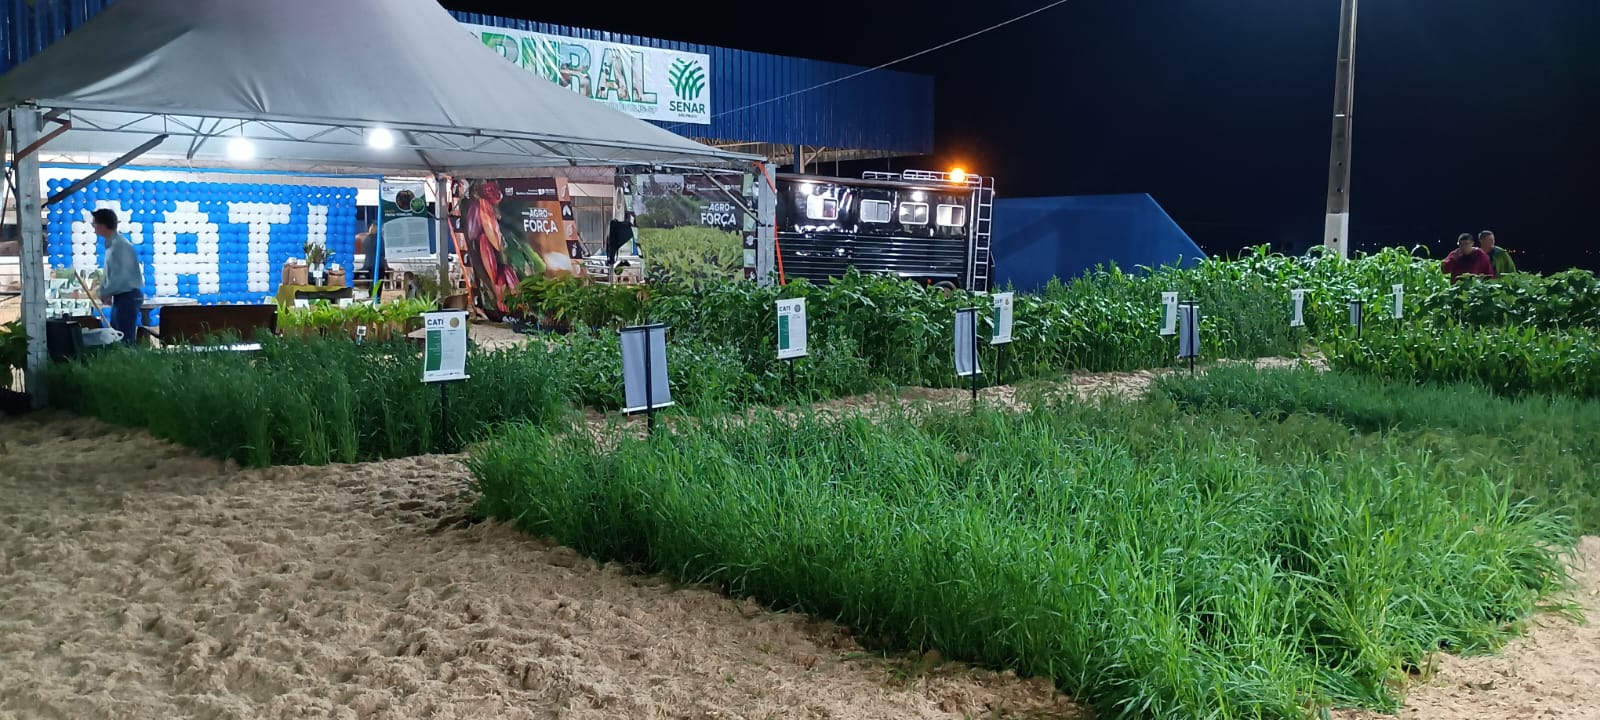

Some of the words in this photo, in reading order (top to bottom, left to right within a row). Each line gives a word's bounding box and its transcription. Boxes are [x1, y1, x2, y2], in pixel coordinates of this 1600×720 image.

[668, 100, 706, 116] SENAR
[529, 208, 548, 218] AGRO
[709, 203, 730, 212] AGRO
[523, 219, 558, 236] FORÇA
[700, 213, 737, 228] FORÇA
[71, 199, 329, 295] CATI
[427, 318, 444, 326] CATI
